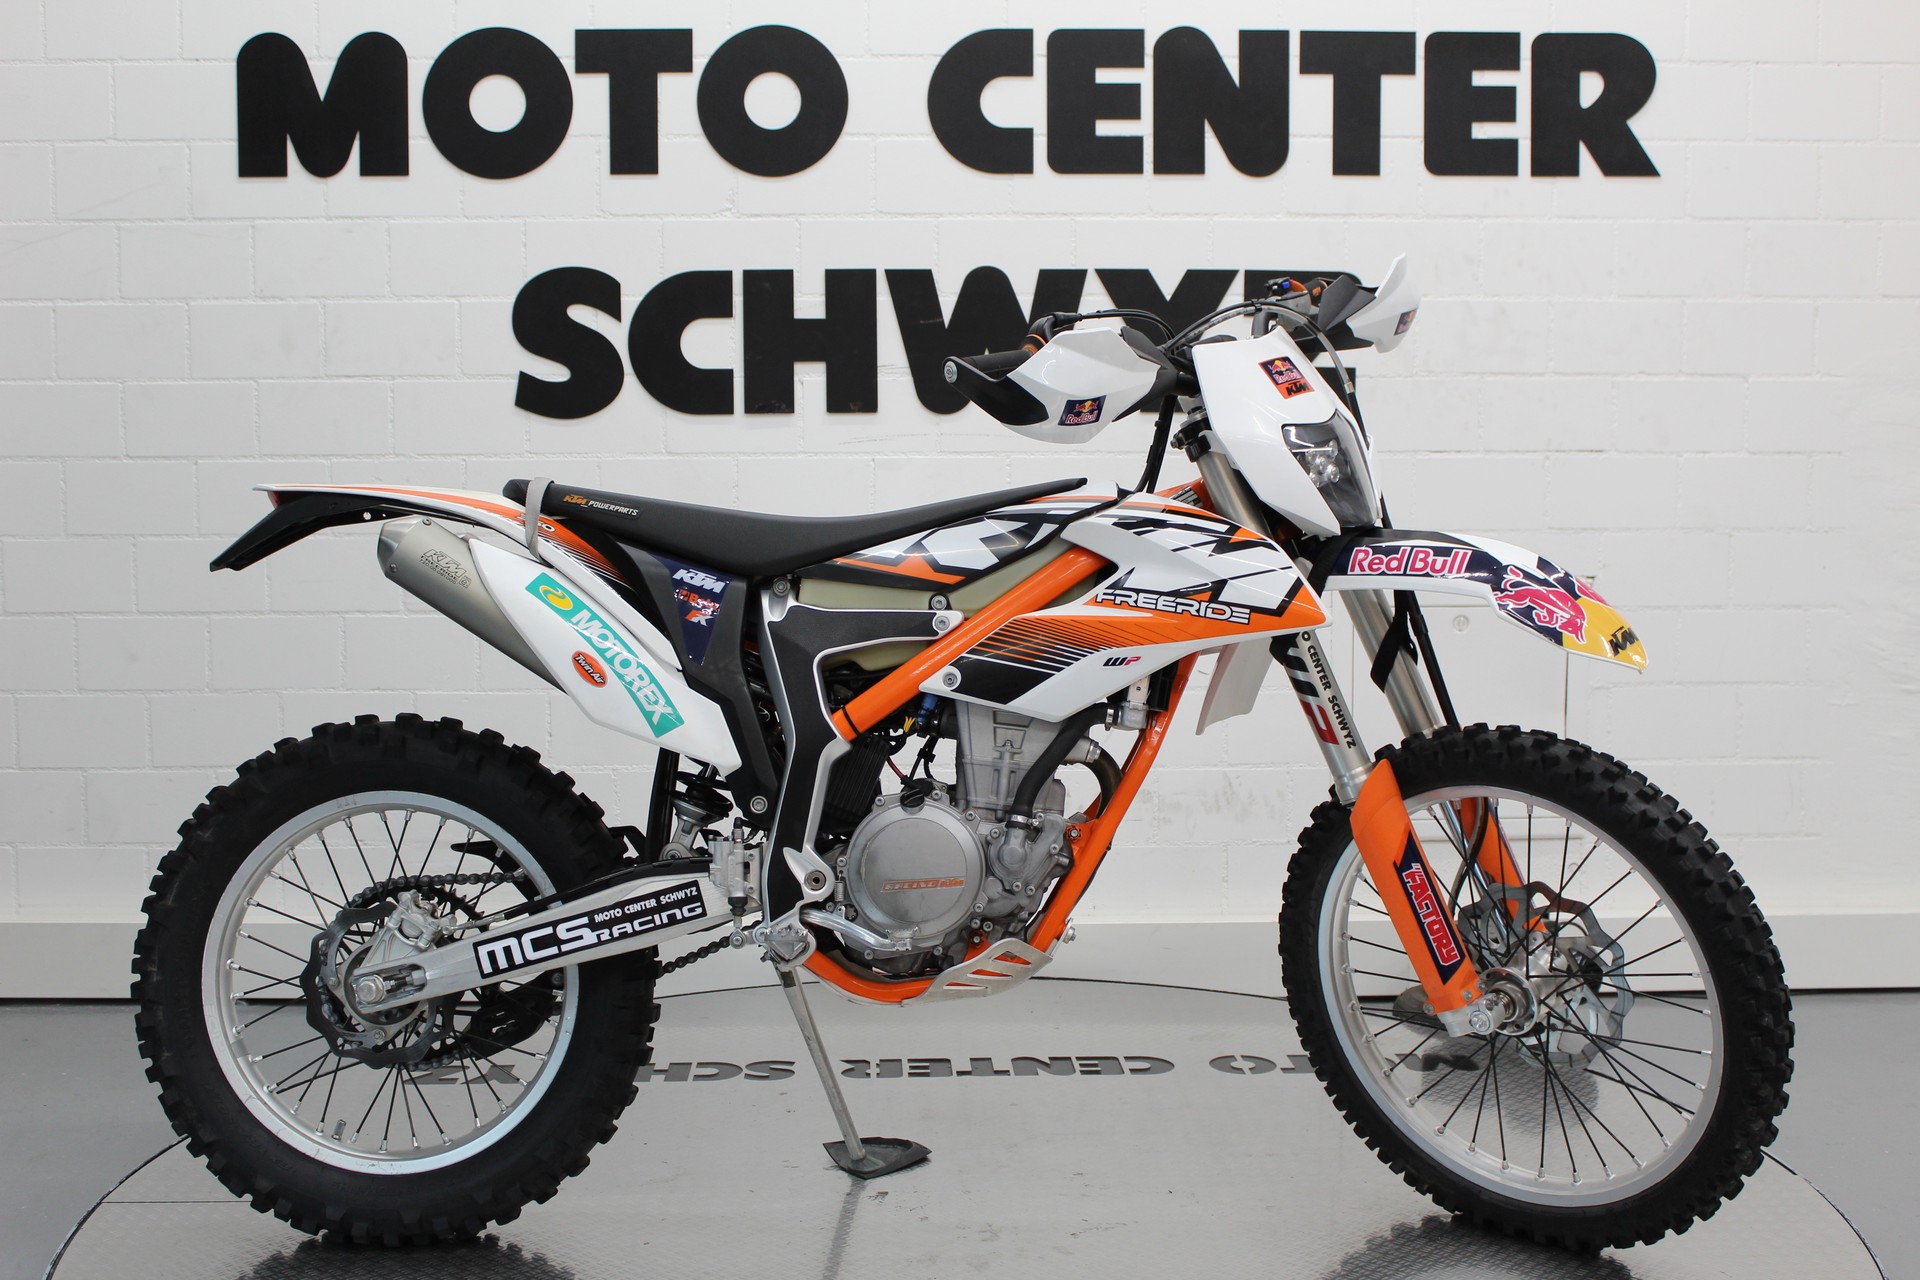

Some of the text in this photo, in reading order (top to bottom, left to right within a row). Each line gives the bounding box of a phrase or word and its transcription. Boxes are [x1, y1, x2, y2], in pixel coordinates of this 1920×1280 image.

[236, 25, 1661, 180] MOTO CENTER
[1285, 380, 1311, 396] KTM
[562, 493, 639, 516] KTM POWERPARTS
[423, 549, 467, 578] KTM
[1347, 546, 1473, 577] Red Bull
[672, 568, 727, 594] KTM
[1096, 588, 1252, 626] FREERIDE
[1608, 625, 1640, 657] KTM
[570, 608, 675, 726] MOTOREX
[573, 652, 606, 685] Twin Air
[1102, 656, 1142, 668] WP
[1307, 644, 1357, 749] CENTER SCHWYZ
[594, 886, 698, 924] MOTO CENTER SCHWYZ
[1402, 862, 1461, 966] FACTORY
[477, 916, 597, 975] MCS
[403, 1060, 796, 1084] SCHYZ
[840, 1055, 1175, 1079] CENTER
